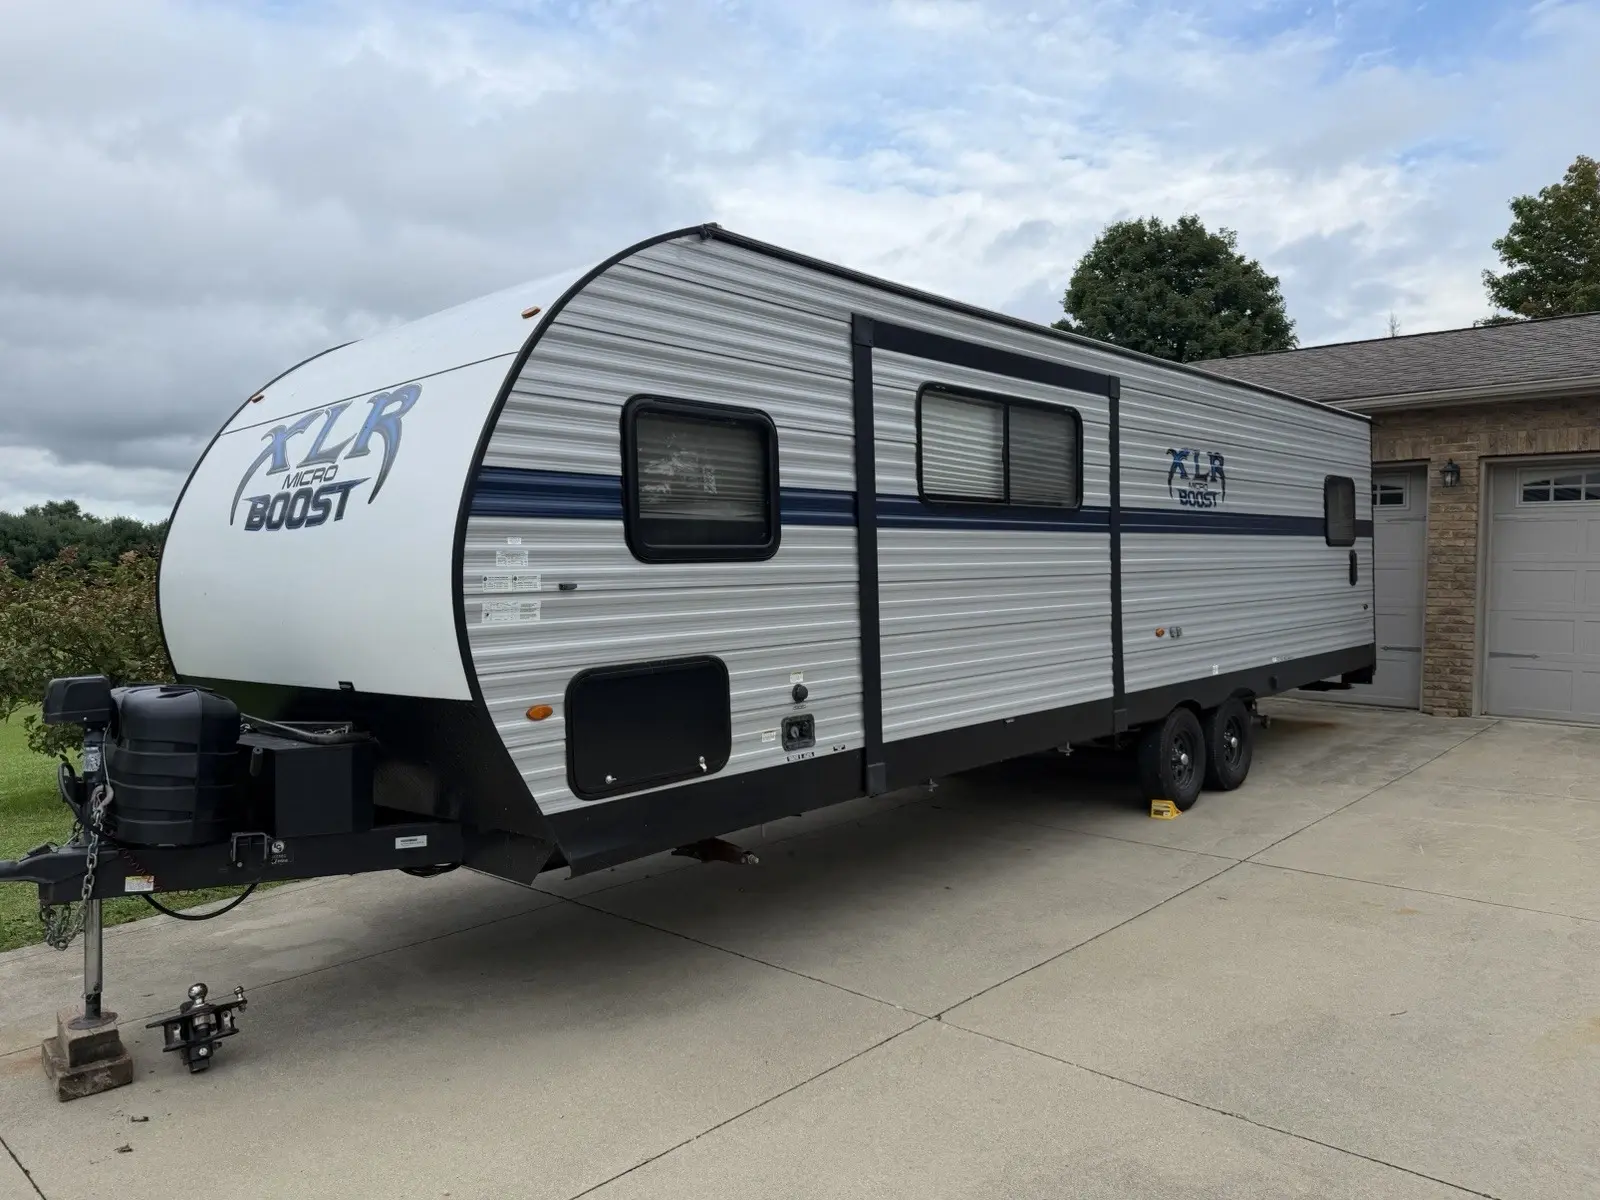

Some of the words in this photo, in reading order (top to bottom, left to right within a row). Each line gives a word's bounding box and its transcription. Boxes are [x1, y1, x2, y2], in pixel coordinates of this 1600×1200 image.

[231, 383, 422, 525] XLR
[282, 465, 339, 489] MICRO
[1166, 448, 1225, 502] XLR
[244, 477, 371, 531] BOOST
[1178, 488, 1220, 507] BOOST
